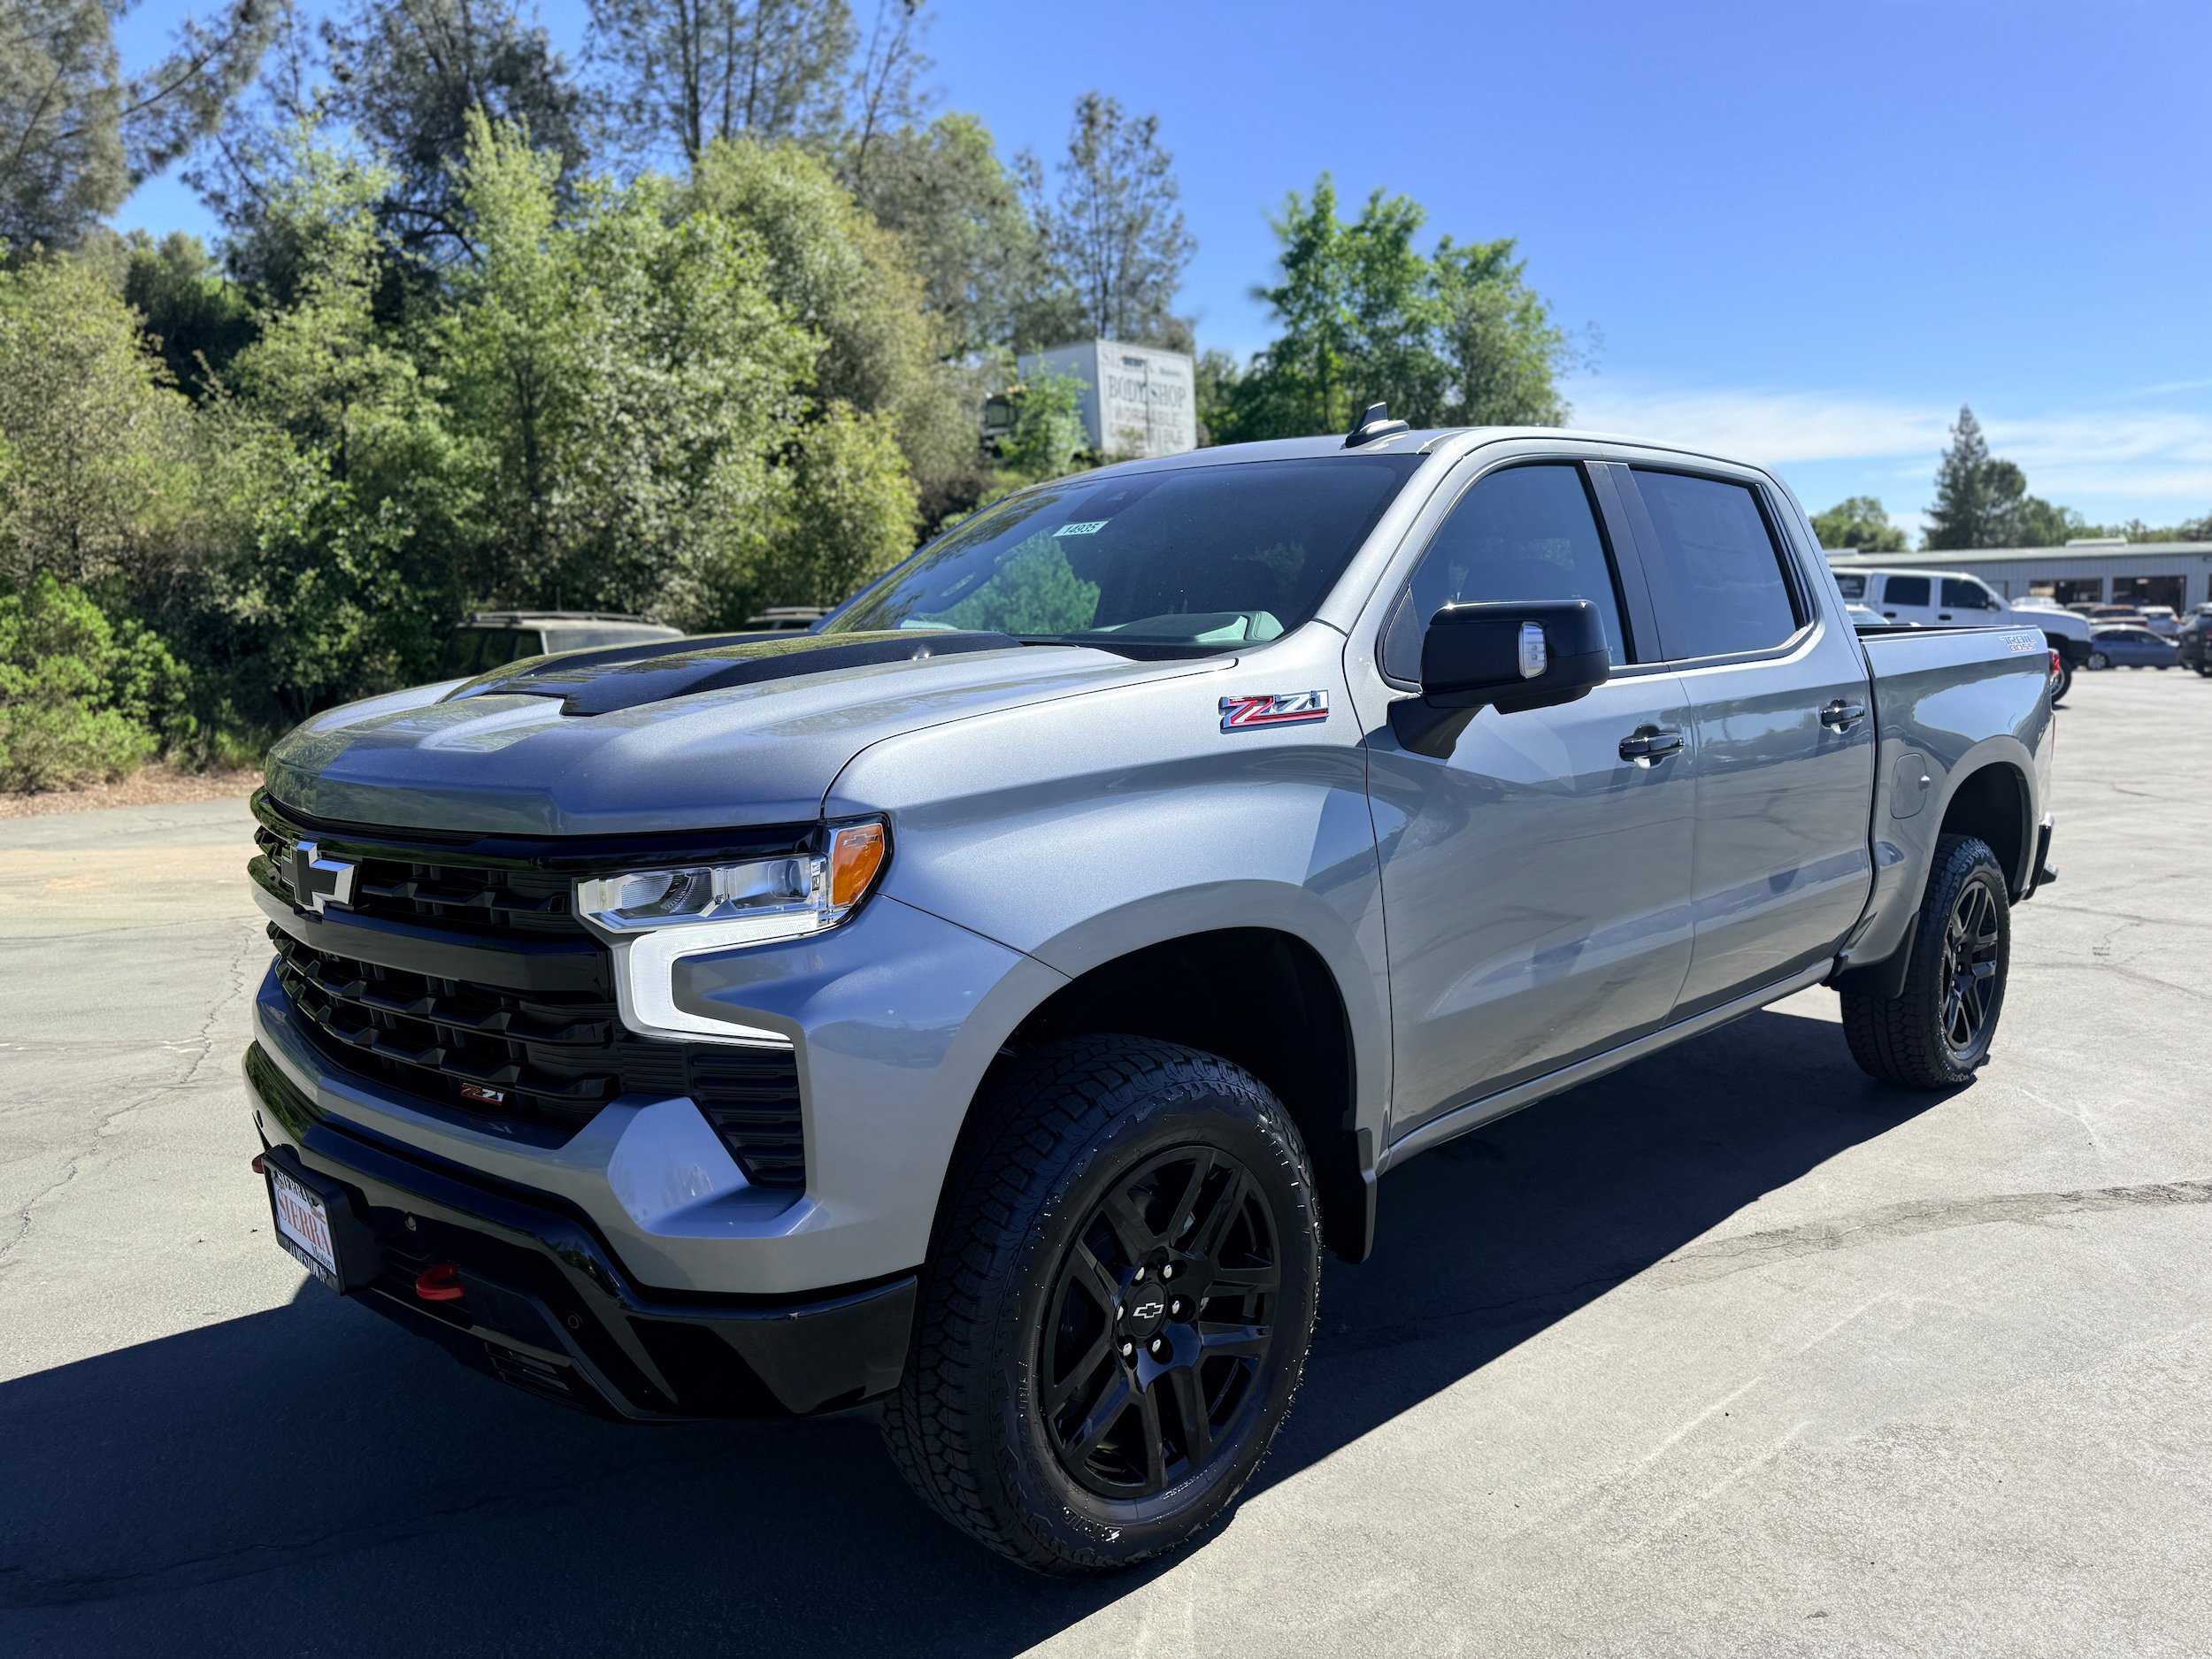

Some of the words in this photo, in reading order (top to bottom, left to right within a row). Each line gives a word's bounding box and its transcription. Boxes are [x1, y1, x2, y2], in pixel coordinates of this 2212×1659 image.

[1108, 375, 1147, 404] BODY
[1151, 382, 1187, 408] SHOP
[1063, 523, 1099, 534] 14935
[2000, 634, 2036, 644] TRAIL
[2009, 643, 2035, 652] BOSS
[1218, 689, 1329, 733] Z71
[461, 1082, 505, 1106] Z71
[276, 1169, 310, 1202] SIERRA
[277, 1189, 333, 1257] SIERRA
[311, 1243, 334, 1271] Motors
